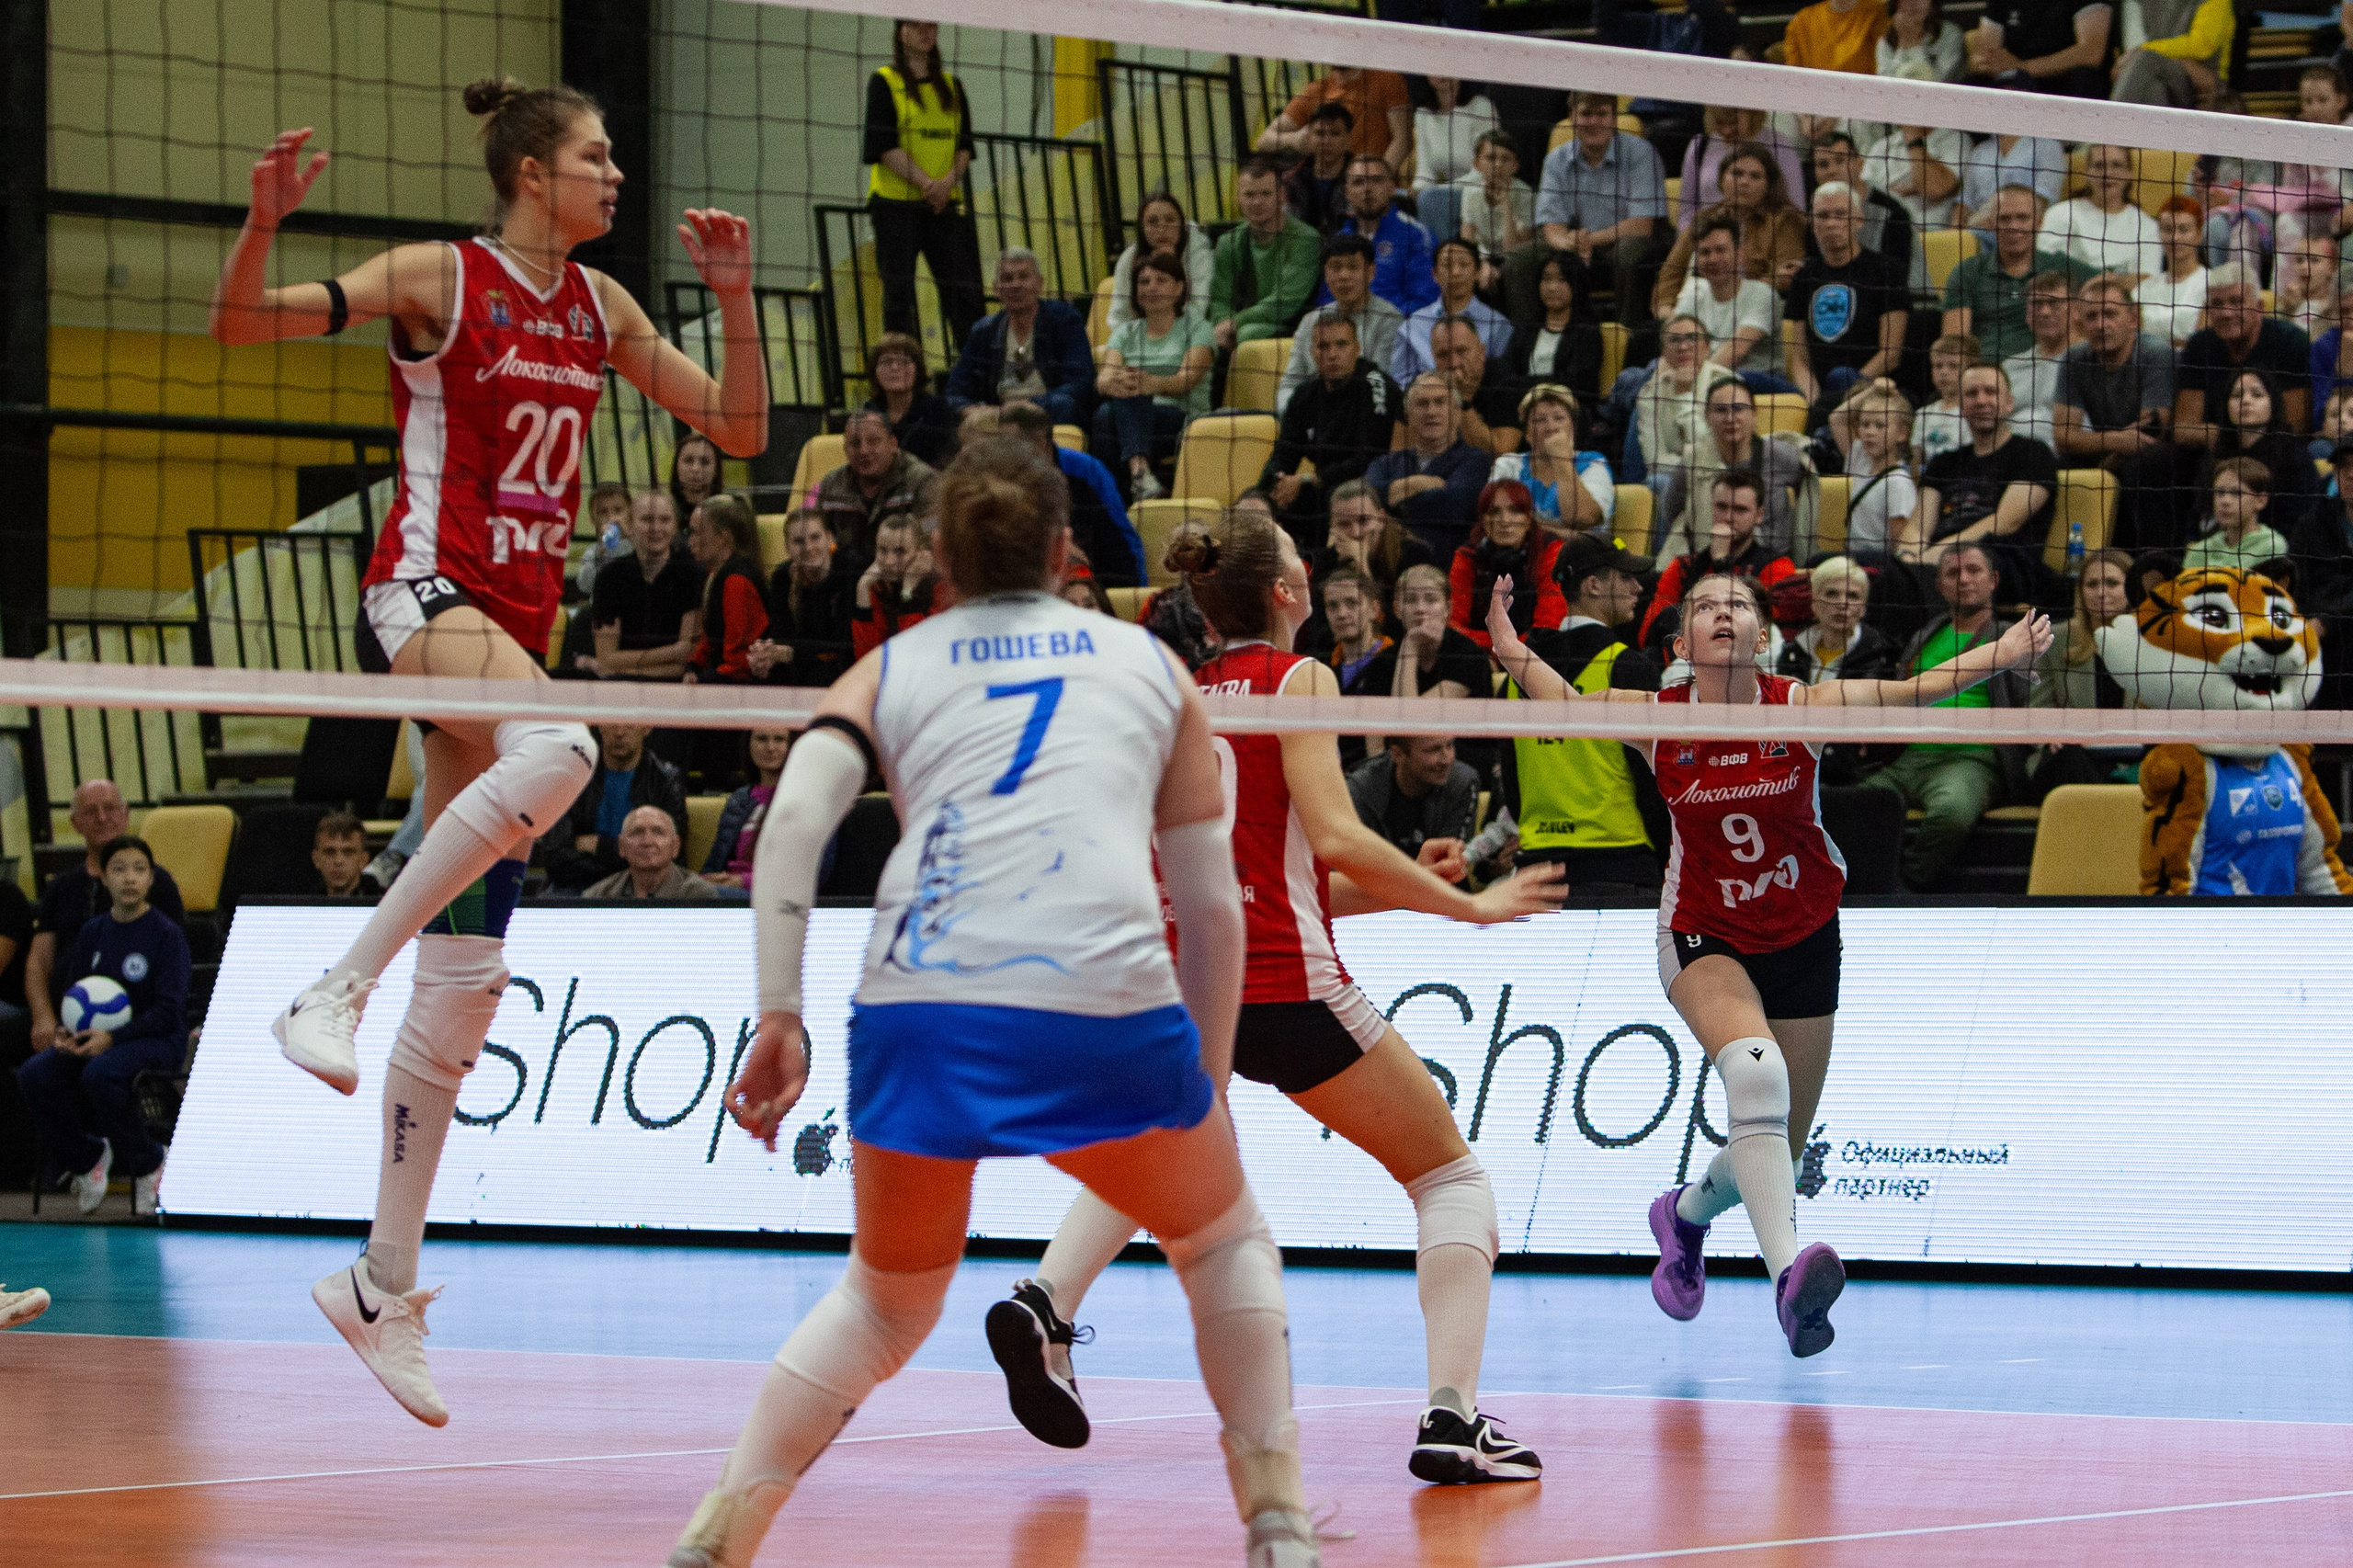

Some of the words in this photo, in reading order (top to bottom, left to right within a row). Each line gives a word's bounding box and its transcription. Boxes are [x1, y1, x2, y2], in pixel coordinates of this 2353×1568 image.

[475, 345, 603, 391] Локомоти
[497, 401, 582, 497] 20
[415, 576, 457, 602] 20
[950, 629, 1096, 665] ГОШЕВА
[985, 676, 1064, 796] 7
[1720, 753, 1748, 767] ВФВ
[1668, 766, 1800, 805] Локомотив
[1721, 813, 1765, 862] 9
